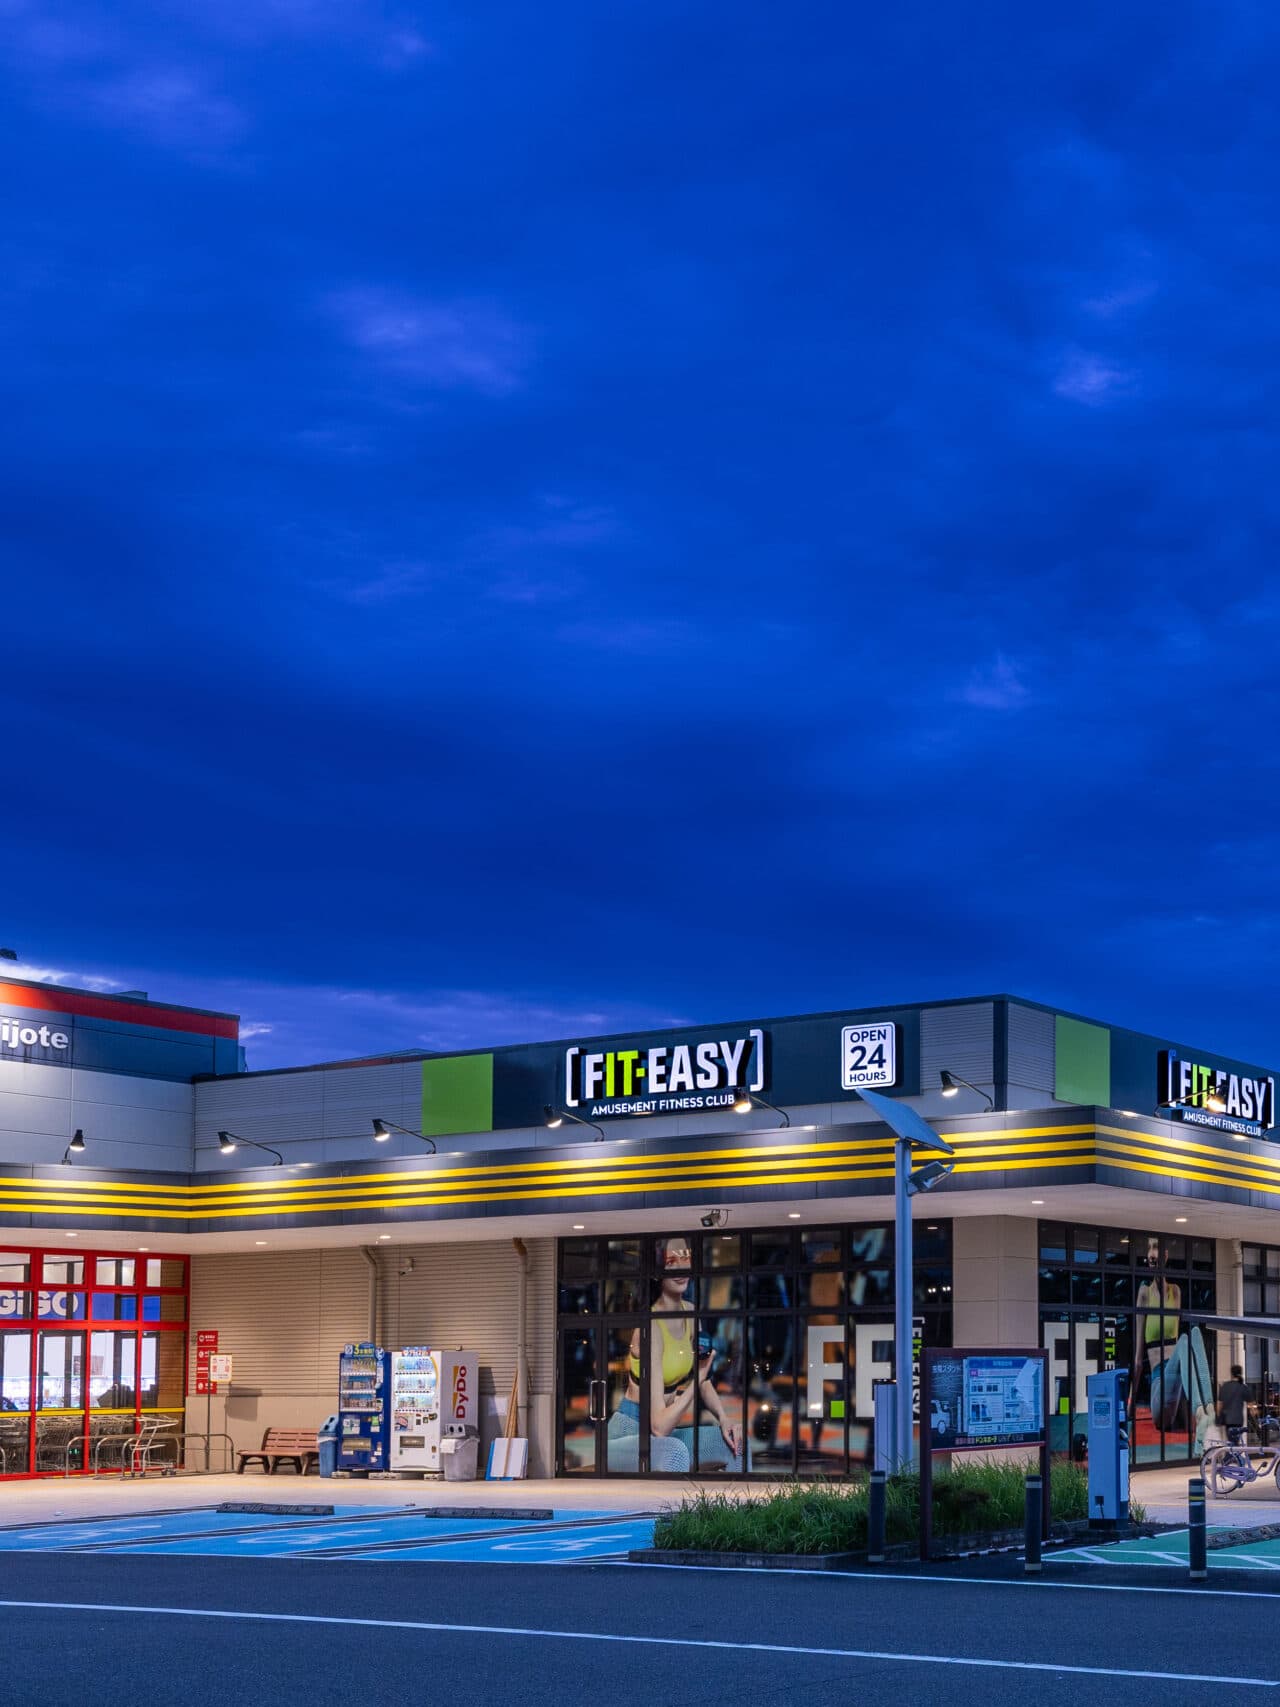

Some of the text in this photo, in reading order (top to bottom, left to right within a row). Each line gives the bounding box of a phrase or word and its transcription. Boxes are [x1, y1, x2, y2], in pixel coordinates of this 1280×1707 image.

[850, 1029, 887, 1043] OPEN
[850, 1043, 887, 1072] 24
[849, 1071, 887, 1083] HOURS
[591, 1094, 735, 1116] AMUSEMENT FITNESS CLUB
[1184, 1111, 1262, 1137] AMUSEMENT FITNESS CLUB
[455, 1365, 469, 1419] DyDo
